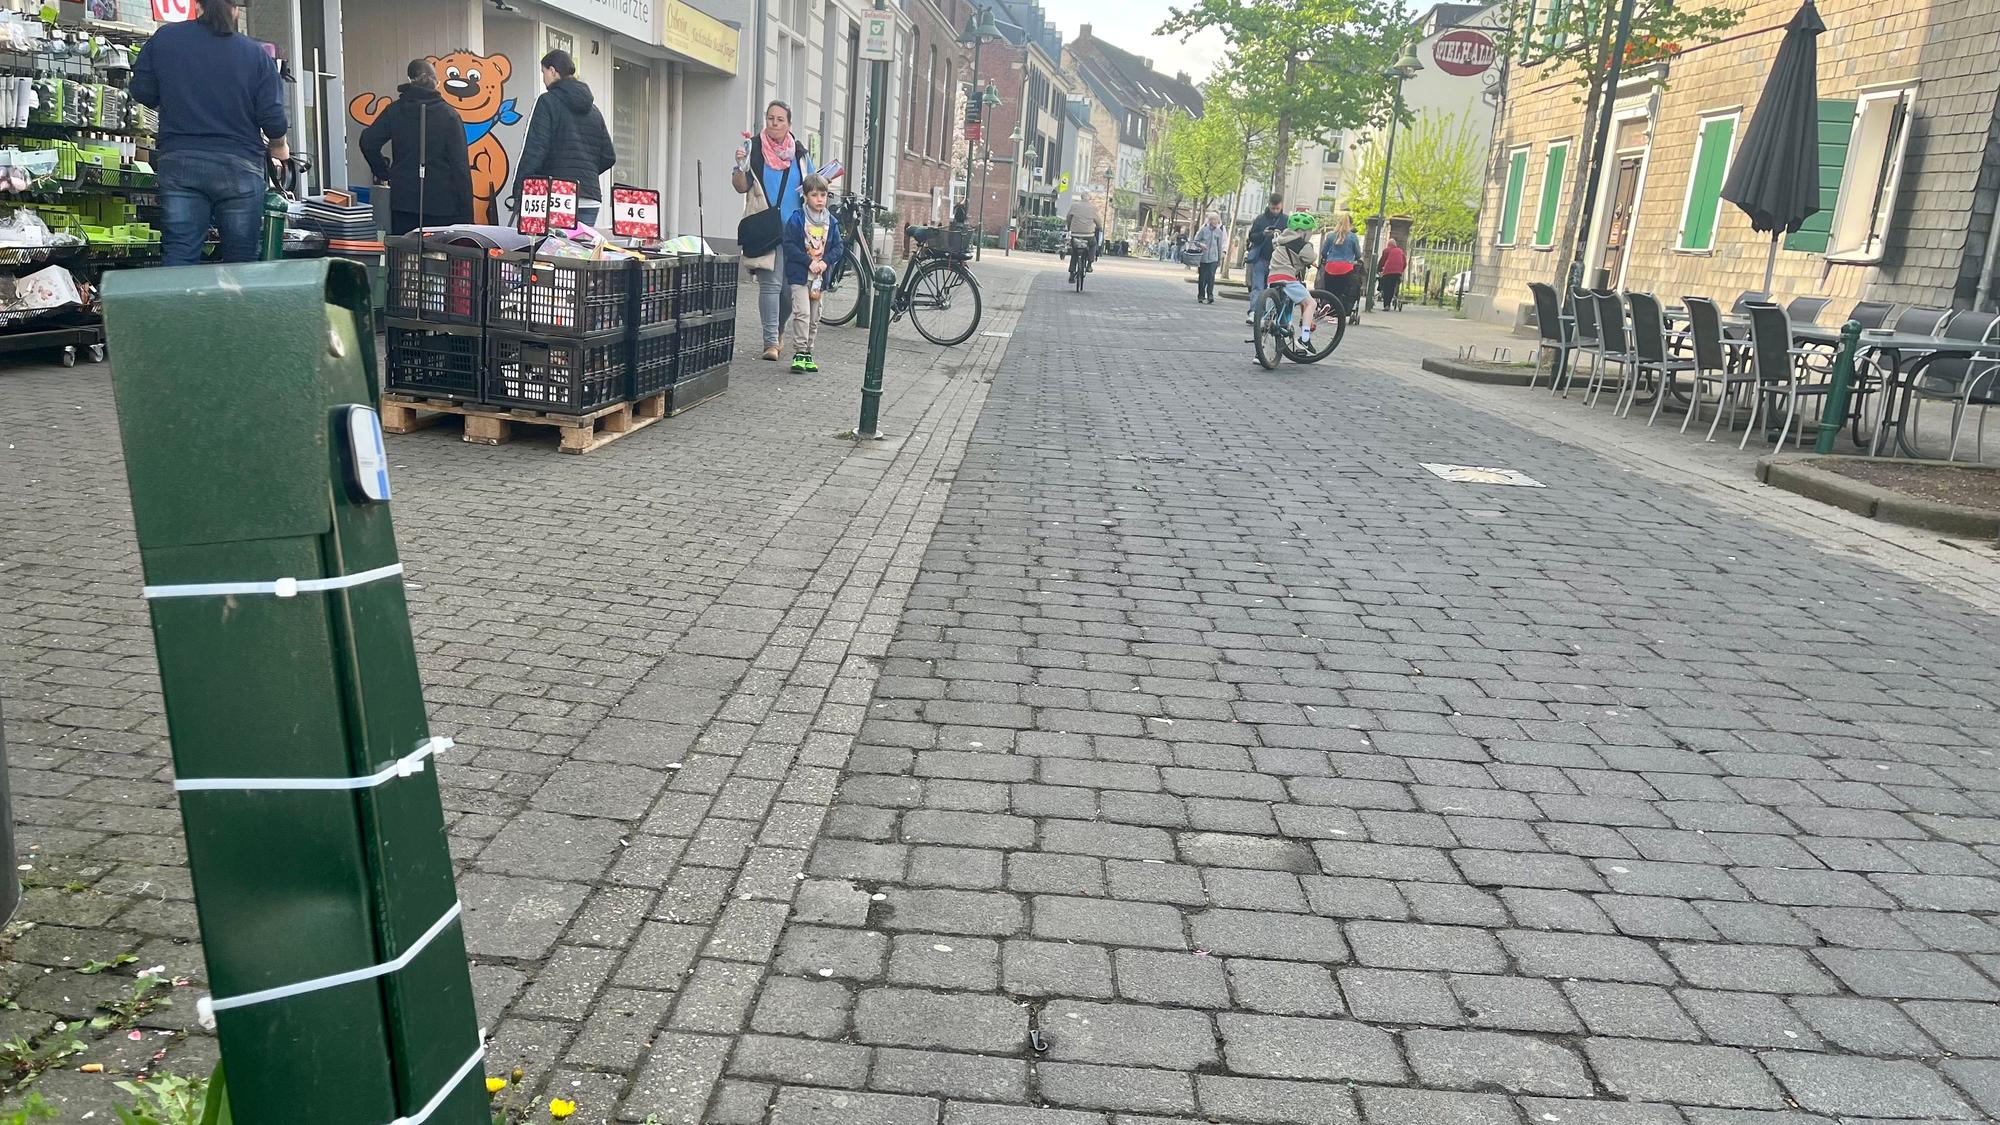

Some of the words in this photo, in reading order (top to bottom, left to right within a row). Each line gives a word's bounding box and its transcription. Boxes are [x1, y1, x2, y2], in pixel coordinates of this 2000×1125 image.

[524, 199, 540, 214] 0,55
[540, 201, 546, 213] €
[564, 198, 572, 210] €
[627, 207, 634, 218] 4
[637, 208, 645, 219] €
